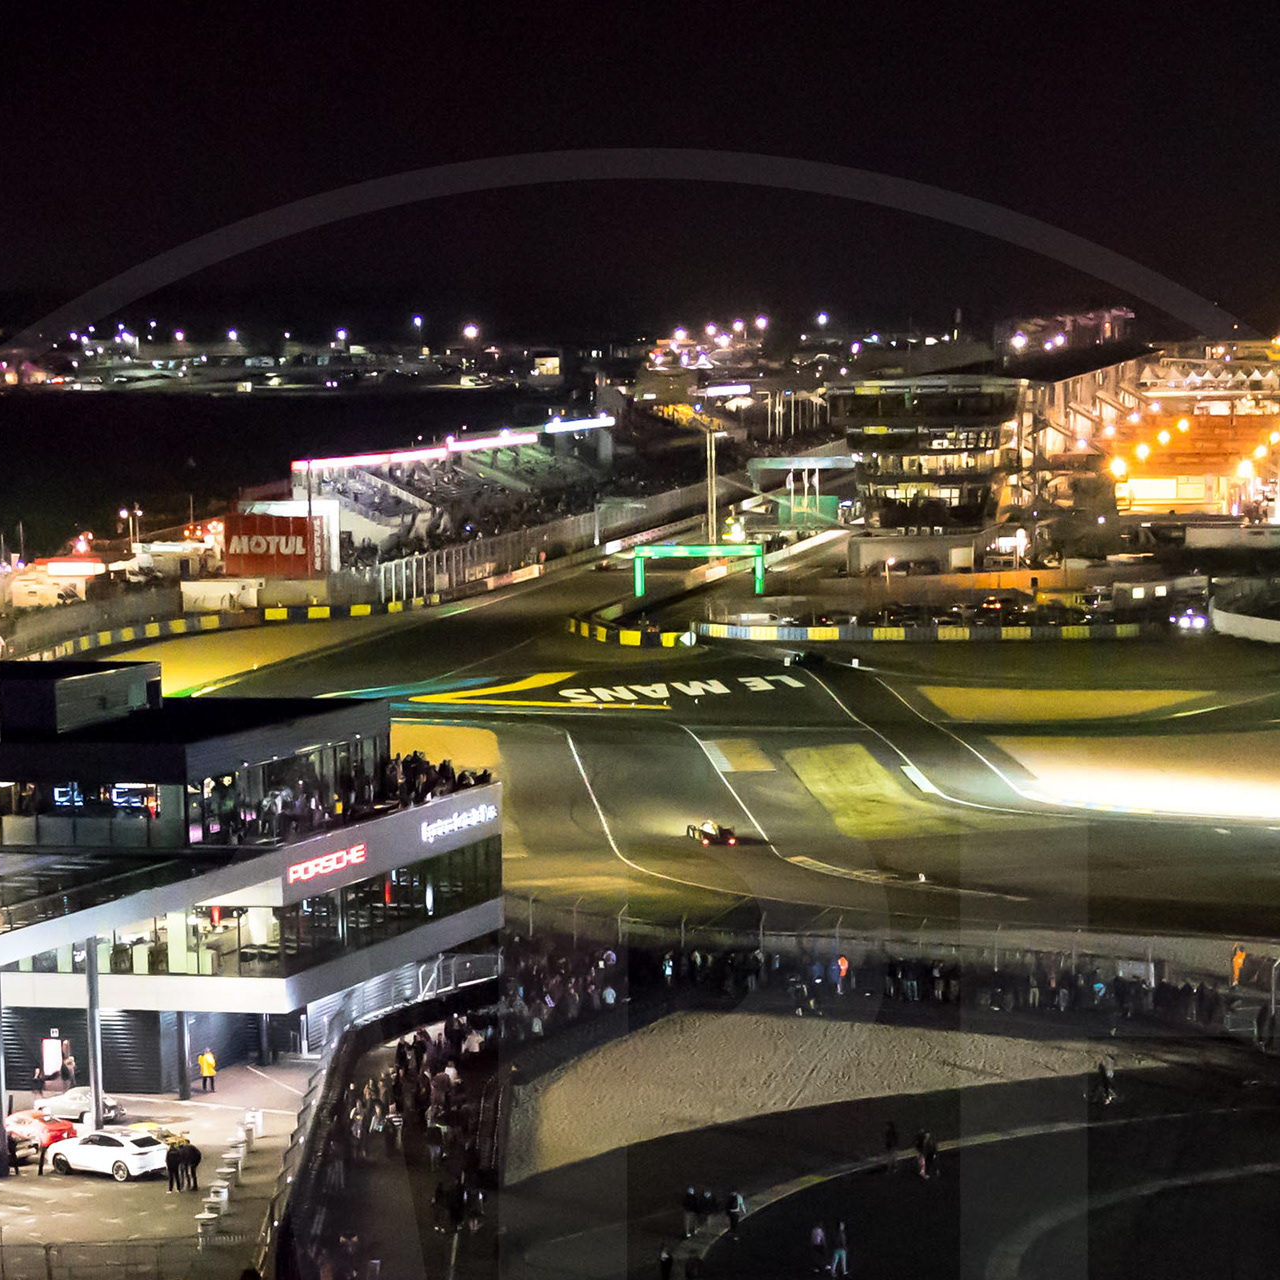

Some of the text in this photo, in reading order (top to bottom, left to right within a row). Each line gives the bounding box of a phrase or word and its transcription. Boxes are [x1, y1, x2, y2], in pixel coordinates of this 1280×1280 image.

[229, 536, 306, 555] MOTUL
[558, 674, 806, 704] LE MANS
[287, 841, 366, 885] PORSCHE
